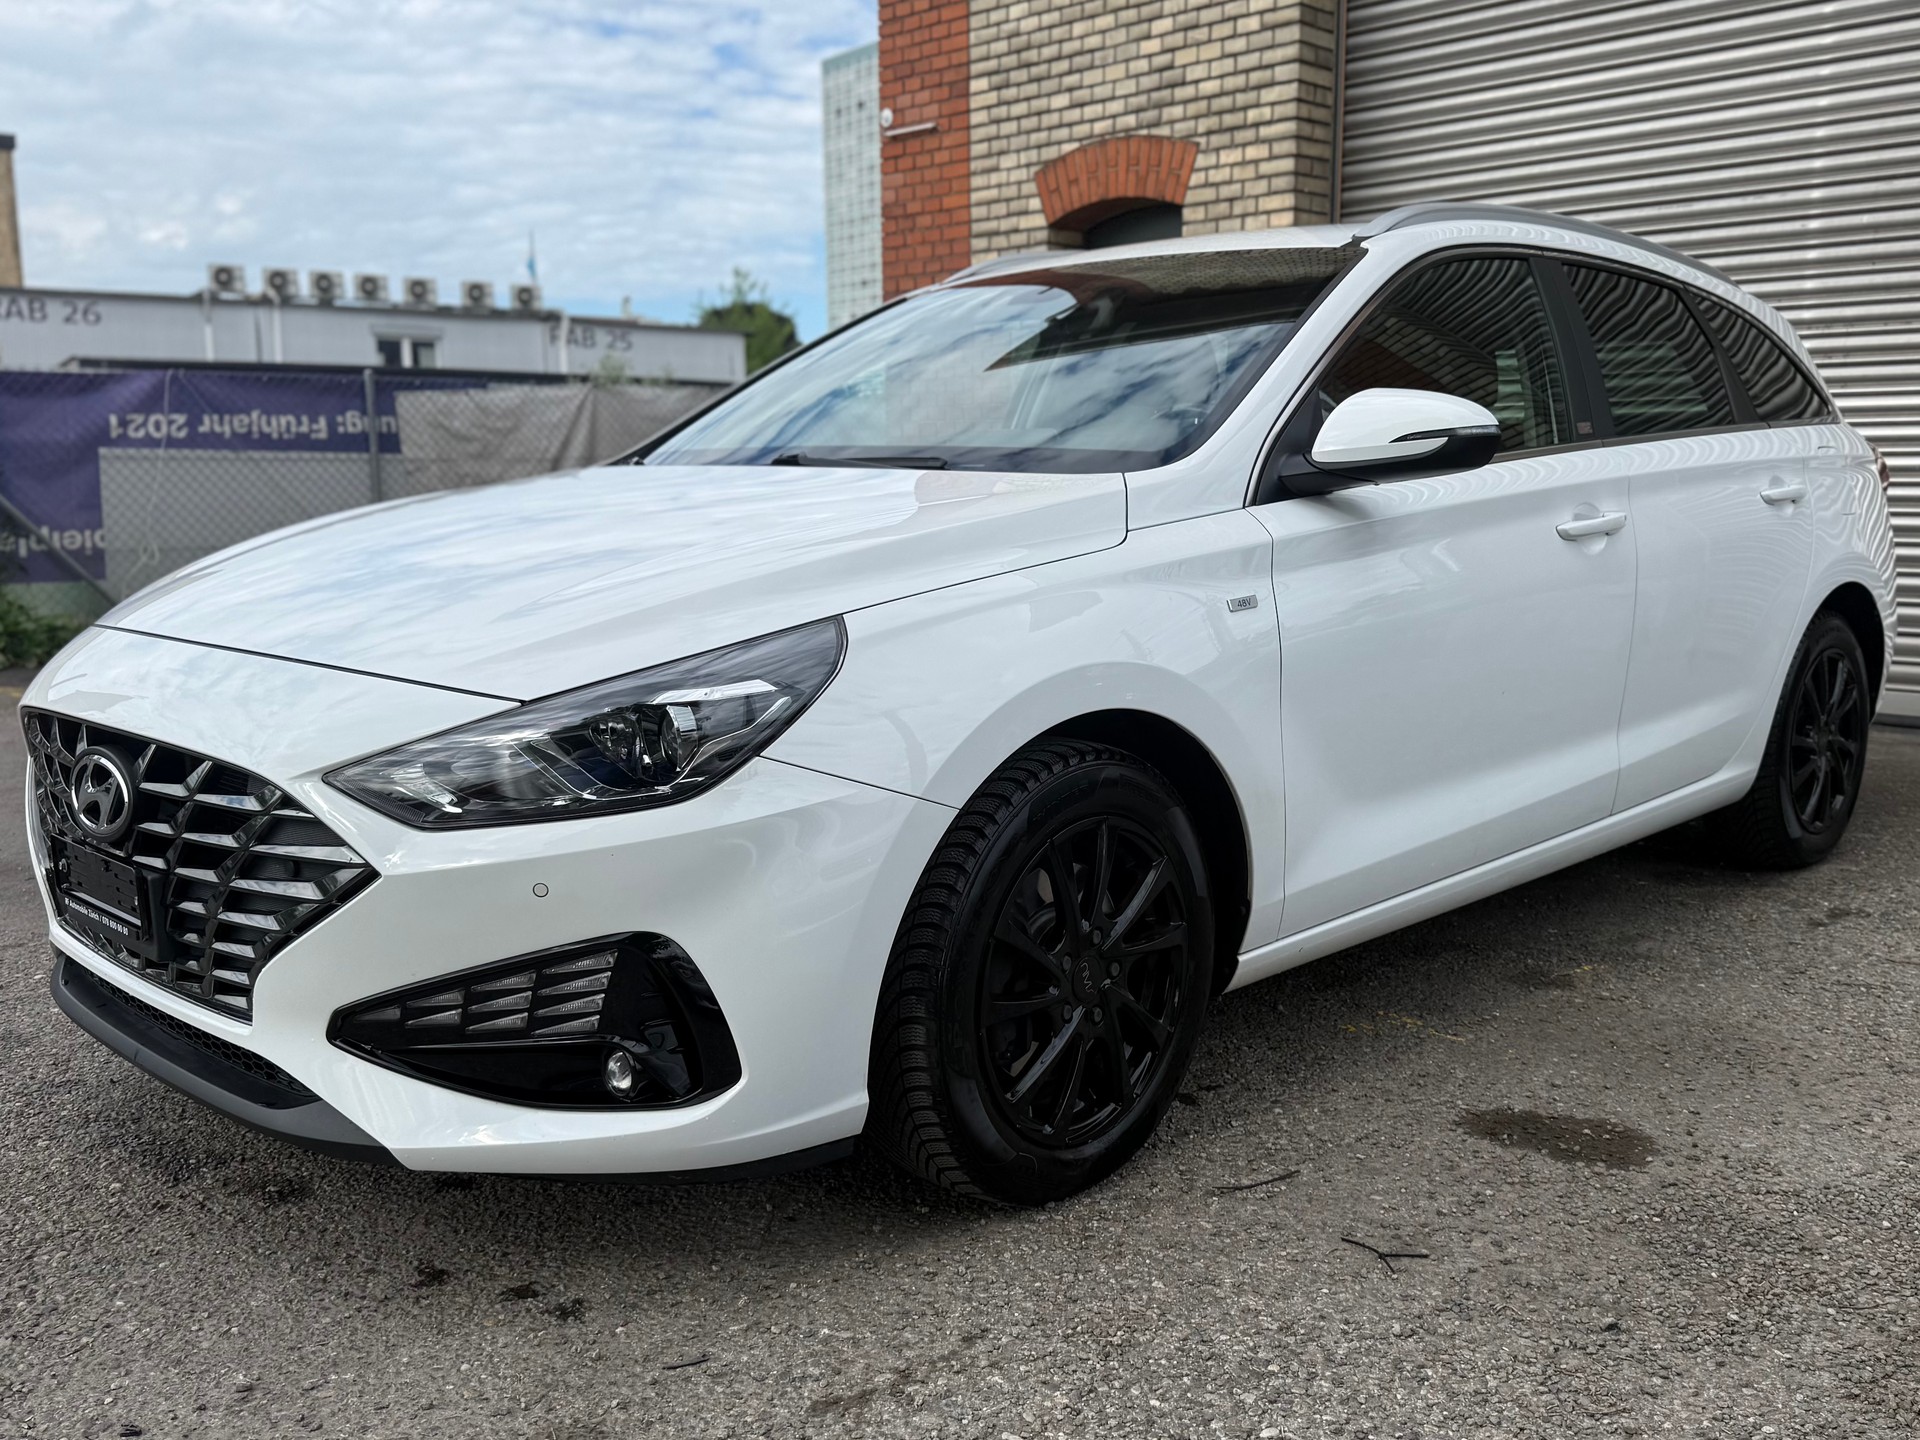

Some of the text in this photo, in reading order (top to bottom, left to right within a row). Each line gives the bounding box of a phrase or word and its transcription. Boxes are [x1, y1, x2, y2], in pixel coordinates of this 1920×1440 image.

[0, 297, 102, 326] AB 26
[605, 327, 634, 353] 25
[108, 413, 188, 439] 2021
[198, 409, 328, 440] Frühjahr
[1237, 598, 1251, 608] 48V
